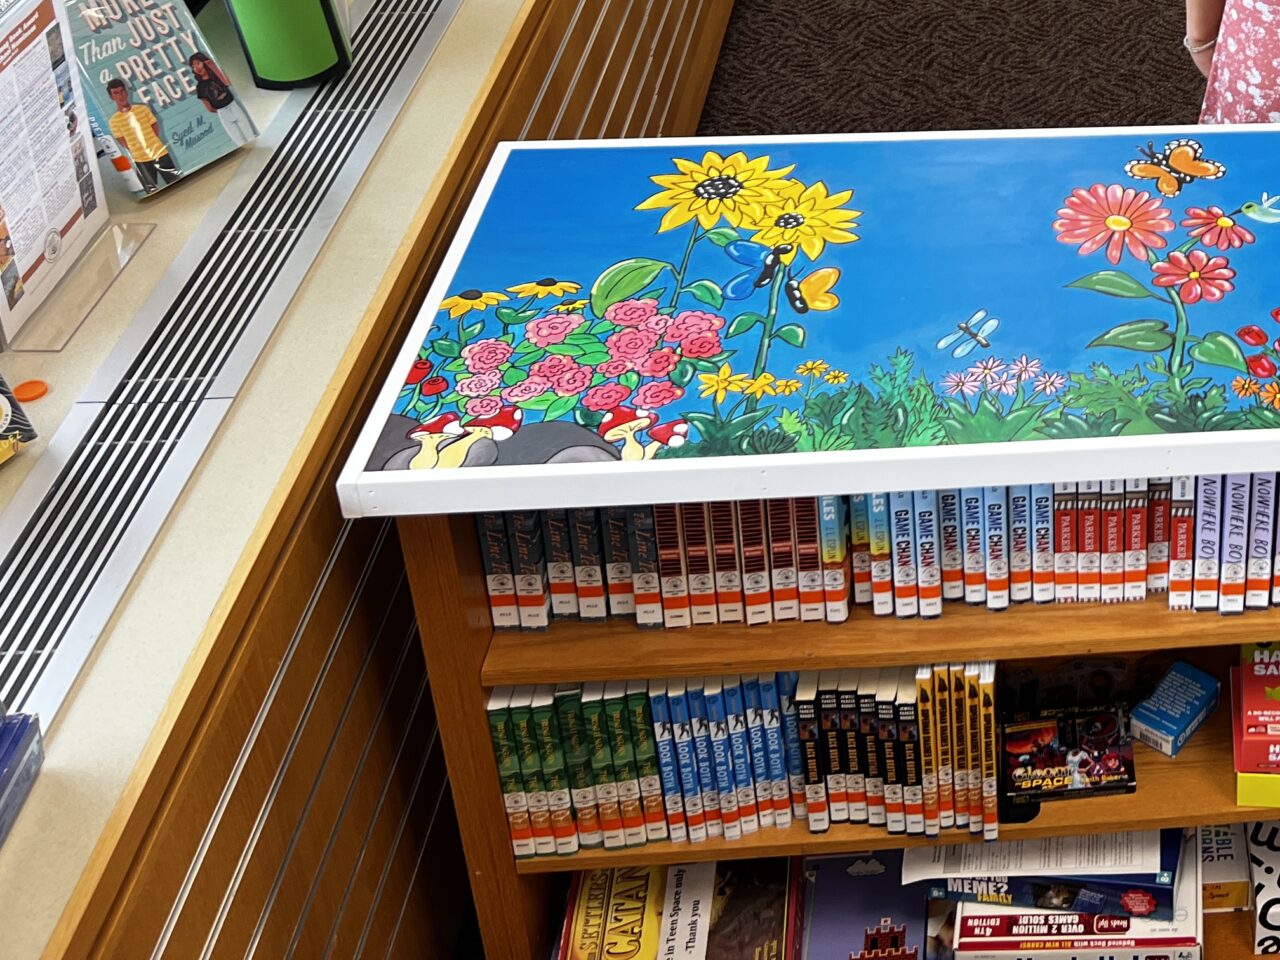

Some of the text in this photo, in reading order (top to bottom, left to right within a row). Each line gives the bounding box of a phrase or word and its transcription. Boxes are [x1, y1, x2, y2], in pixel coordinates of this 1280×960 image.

[79, 36, 127, 67] Than
[126, 3, 181, 48] JUST
[99, 29, 201, 89] a PRETTY
[137, 66, 199, 108] FACE
[941, 494, 957, 522] GAME
[965, 497, 980, 526] GAME
[988, 503, 1002, 532] GAME
[1012, 496, 1027, 524] GAME
[1035, 497, 1050, 525] GAME
[1201, 477, 1218, 533] NOWHERE
[1228, 482, 1246, 538] NOWHERE
[1255, 477, 1272, 533] NOWHERE
[894, 509, 910, 539] GAME
[918, 510, 934, 539] GAME
[1061, 515, 1071, 552] PARKER
[1085, 515, 1094, 550] PARKER
[1108, 516, 1117, 552] PARKER
[1131, 513, 1141, 550] PARKER
[1154, 505, 1164, 541] PARKER
[1177, 522, 1187, 559] PARKER
[659, 740, 675, 792] LOOK BOTH
[677, 741, 694, 790] LOOK BOTH
[695, 736, 712, 787] LOOK BOTH
[713, 740, 729, 791] LOOK BOTH
[731, 732, 747, 781] LOOK BOTH
[750, 726, 766, 775] LOOK BOTH
[767, 728, 783, 775] LOOK BOTH
[1021, 777, 1073, 789] SPACE
[674, 868, 687, 890] only
[947, 878, 1009, 894] MEME?
[579, 872, 609, 951] SETTLERS
[670, 890, 682, 918] Space
[691, 898, 701, 918] you
[976, 891, 1013, 905] FAMILY
[666, 918, 678, 944] Teen
[967, 917, 1000, 927] EDITION
[1012, 924, 1048, 934] MILLION
[1018, 915, 1079, 924] GAMES SOLD!
[1060, 924, 1085, 933] OVER
